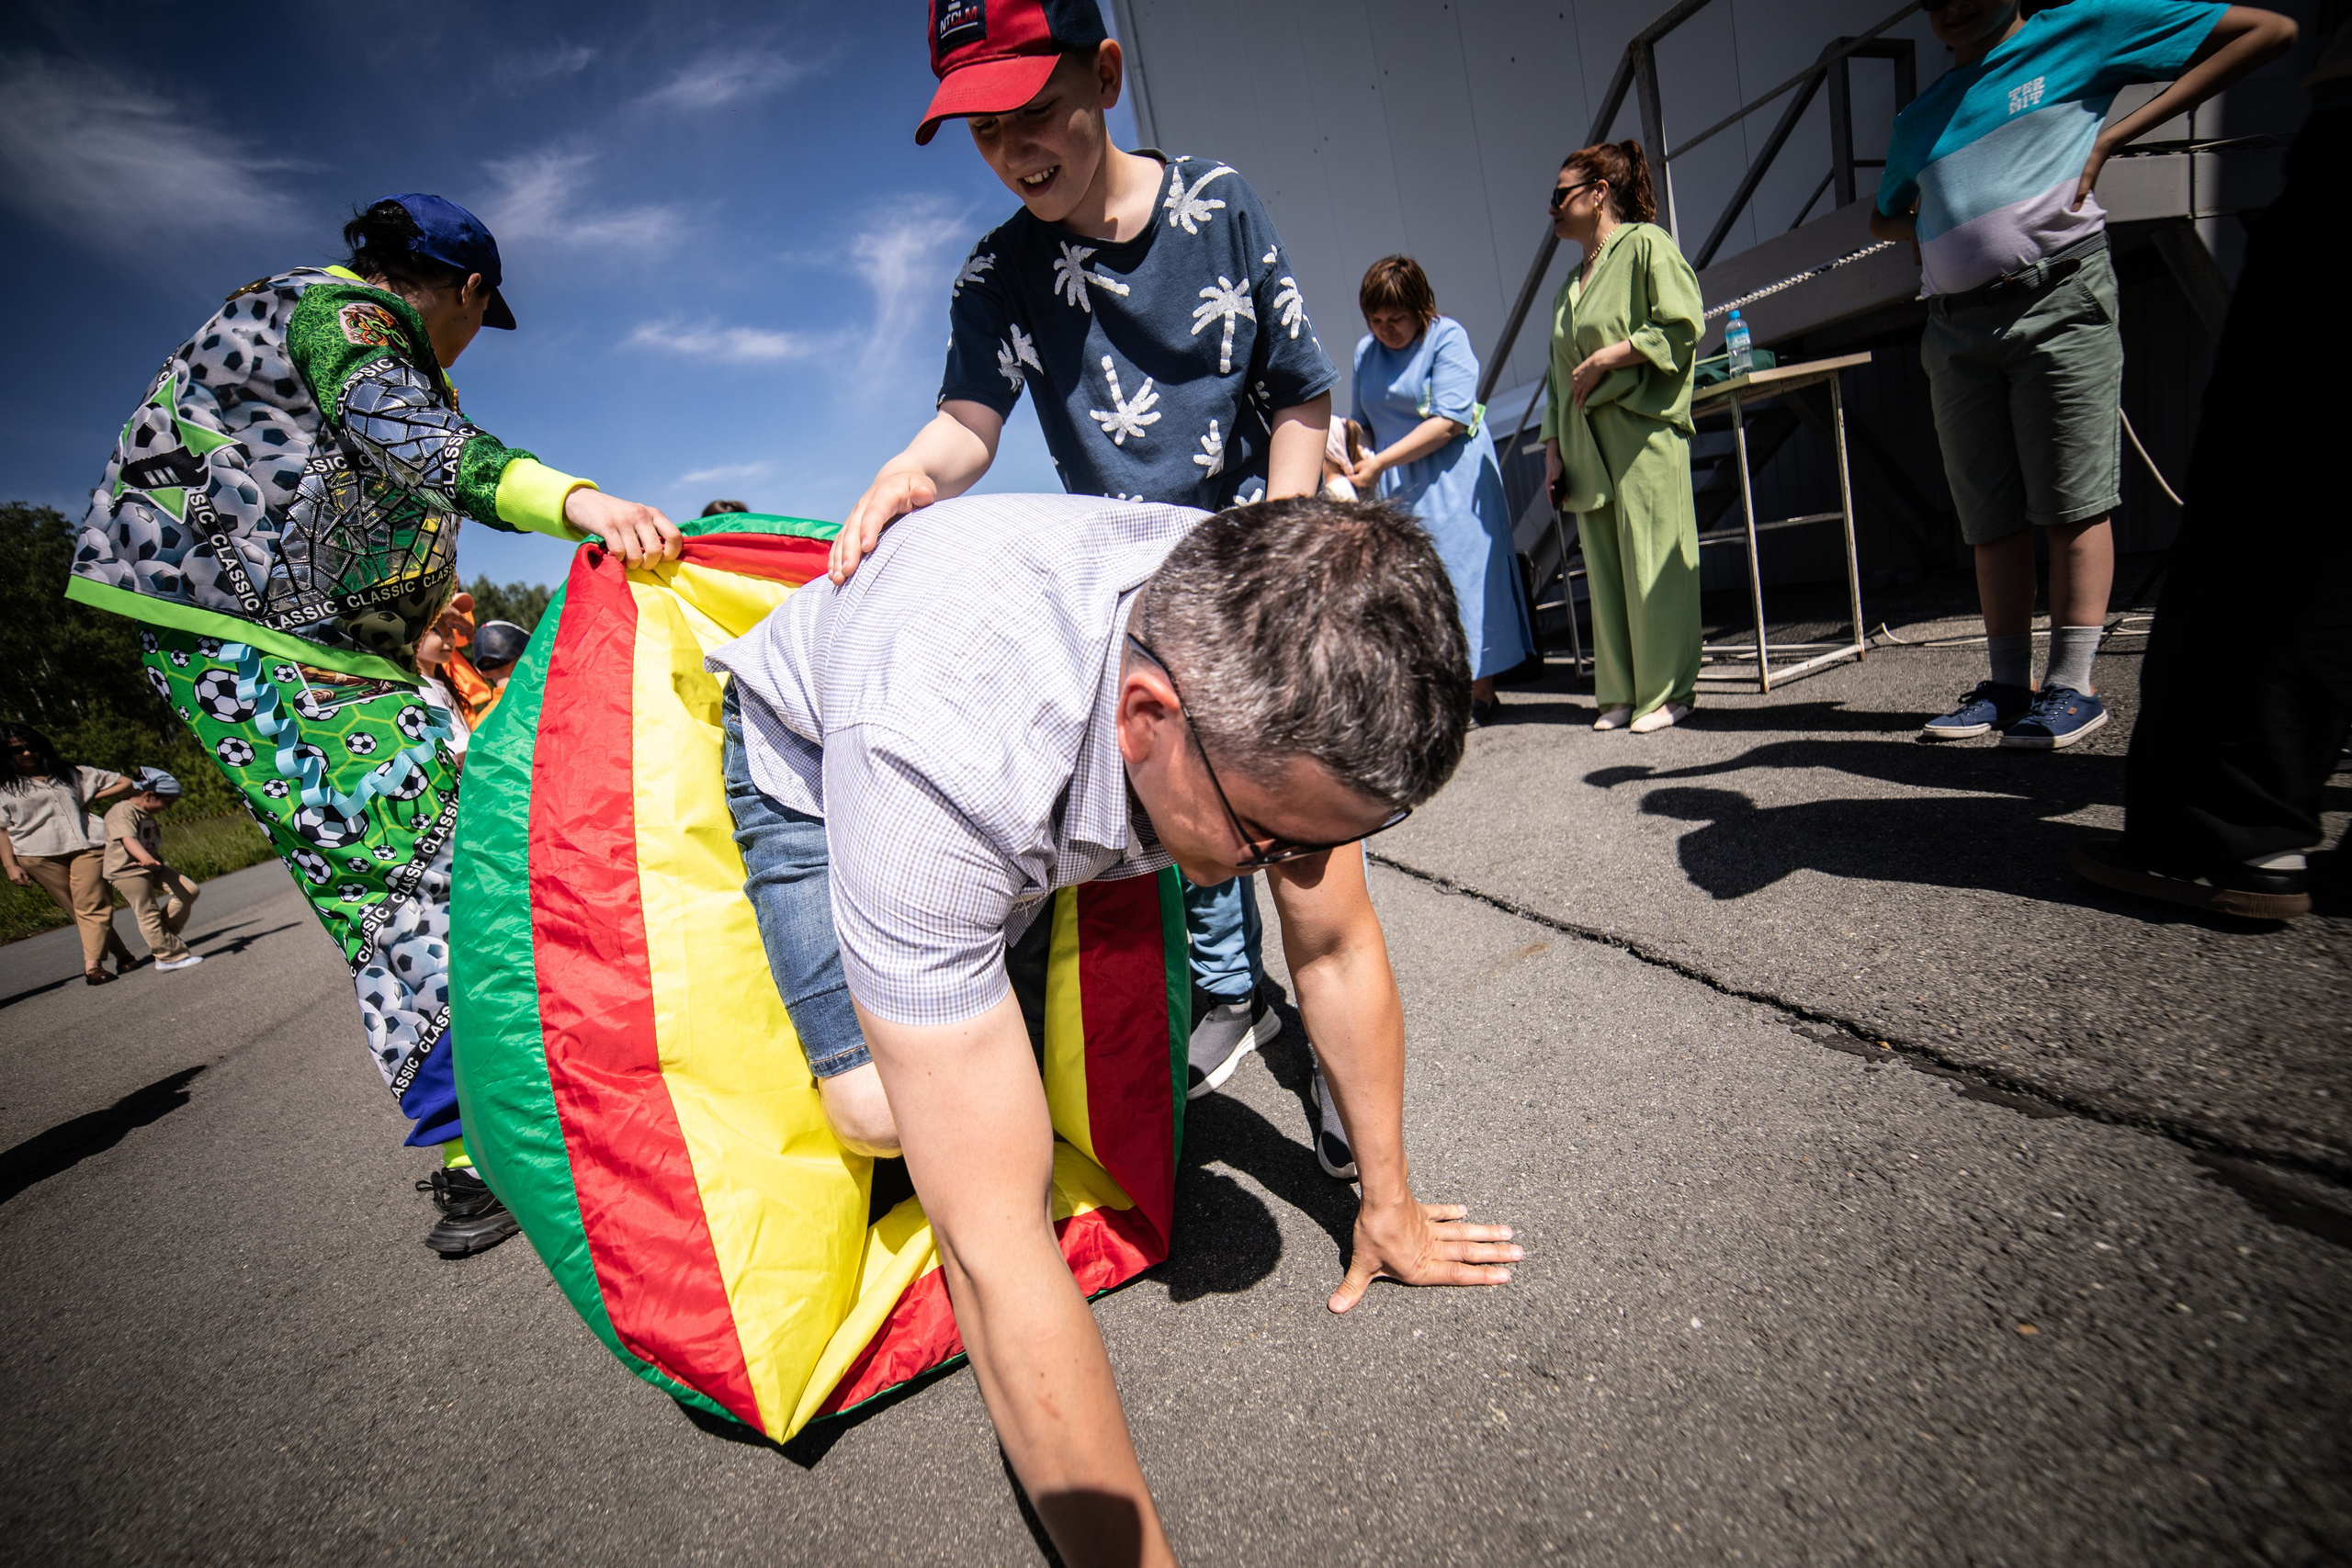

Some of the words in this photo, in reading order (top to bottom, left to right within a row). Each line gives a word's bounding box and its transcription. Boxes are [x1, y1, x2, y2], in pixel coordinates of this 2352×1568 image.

[336, 358, 394, 416] CLASSIC
[443, 428, 477, 500] CLASSIC
[211, 534, 260, 611] CLASSIC
[255, 601, 338, 631] LASSIC
[347, 581, 415, 608] CLASSIC
[357, 907, 390, 963] CLASSIC
[390, 859, 426, 904] CLASSIC
